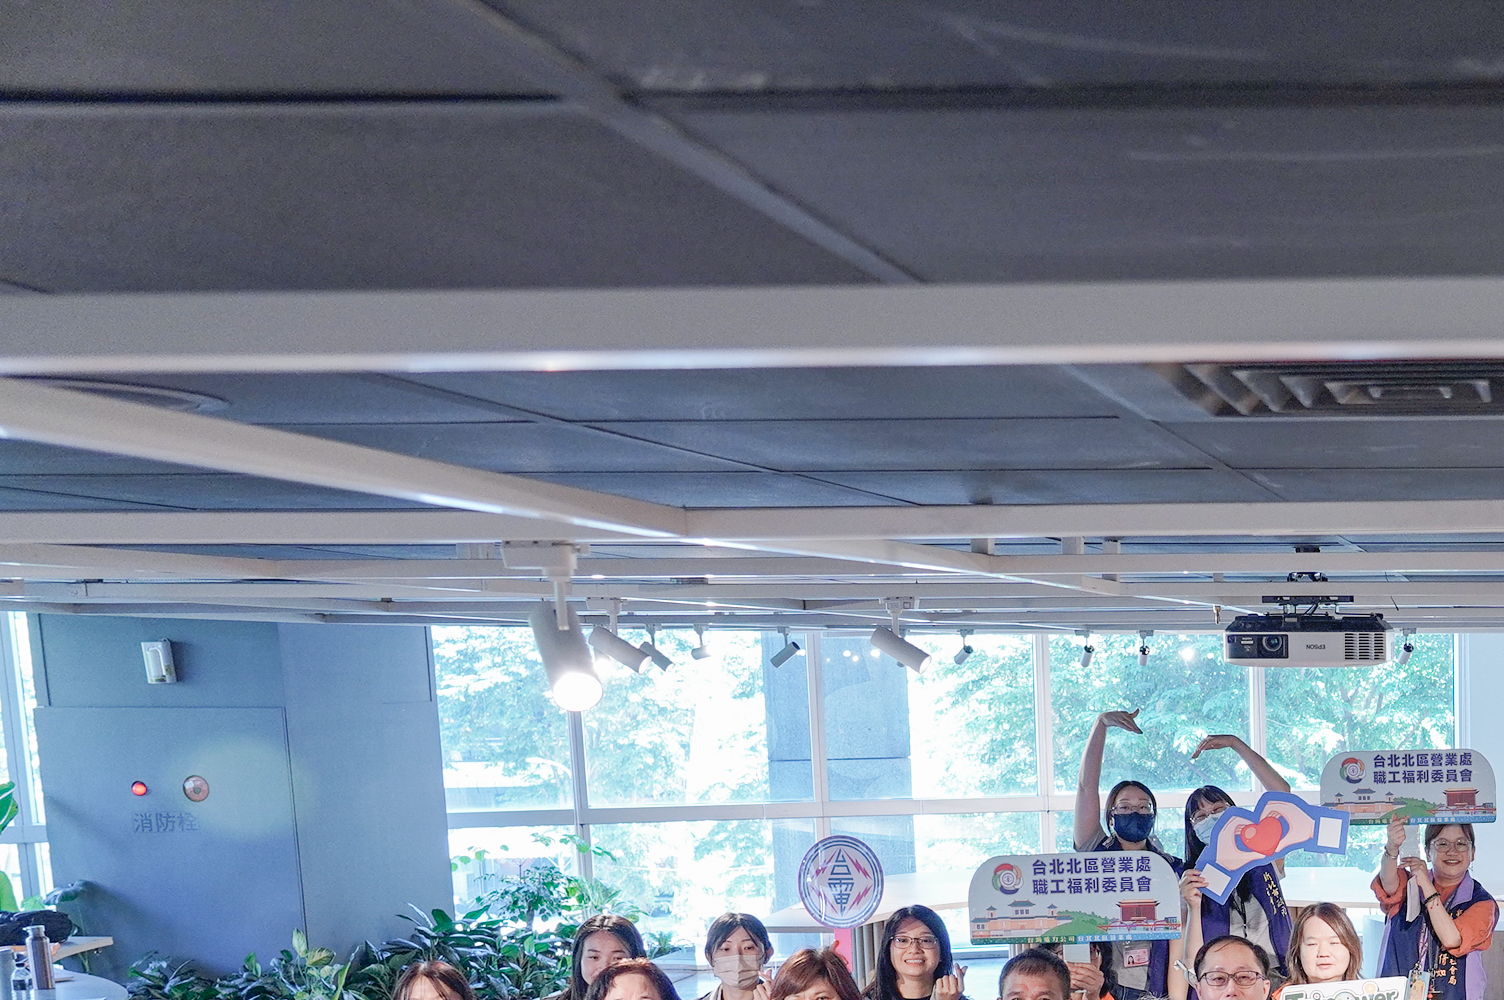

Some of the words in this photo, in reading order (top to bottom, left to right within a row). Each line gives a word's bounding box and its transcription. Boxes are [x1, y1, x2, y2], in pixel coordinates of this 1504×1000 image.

[1373, 752, 1472, 768] 台北北區營業處
[1373, 769, 1472, 784] 職工福利委員會
[134, 812, 198, 832] 消防栓
[1032, 857, 1151, 876] 台北北區營業處
[1032, 876, 1152, 896] 職工福利委員會
